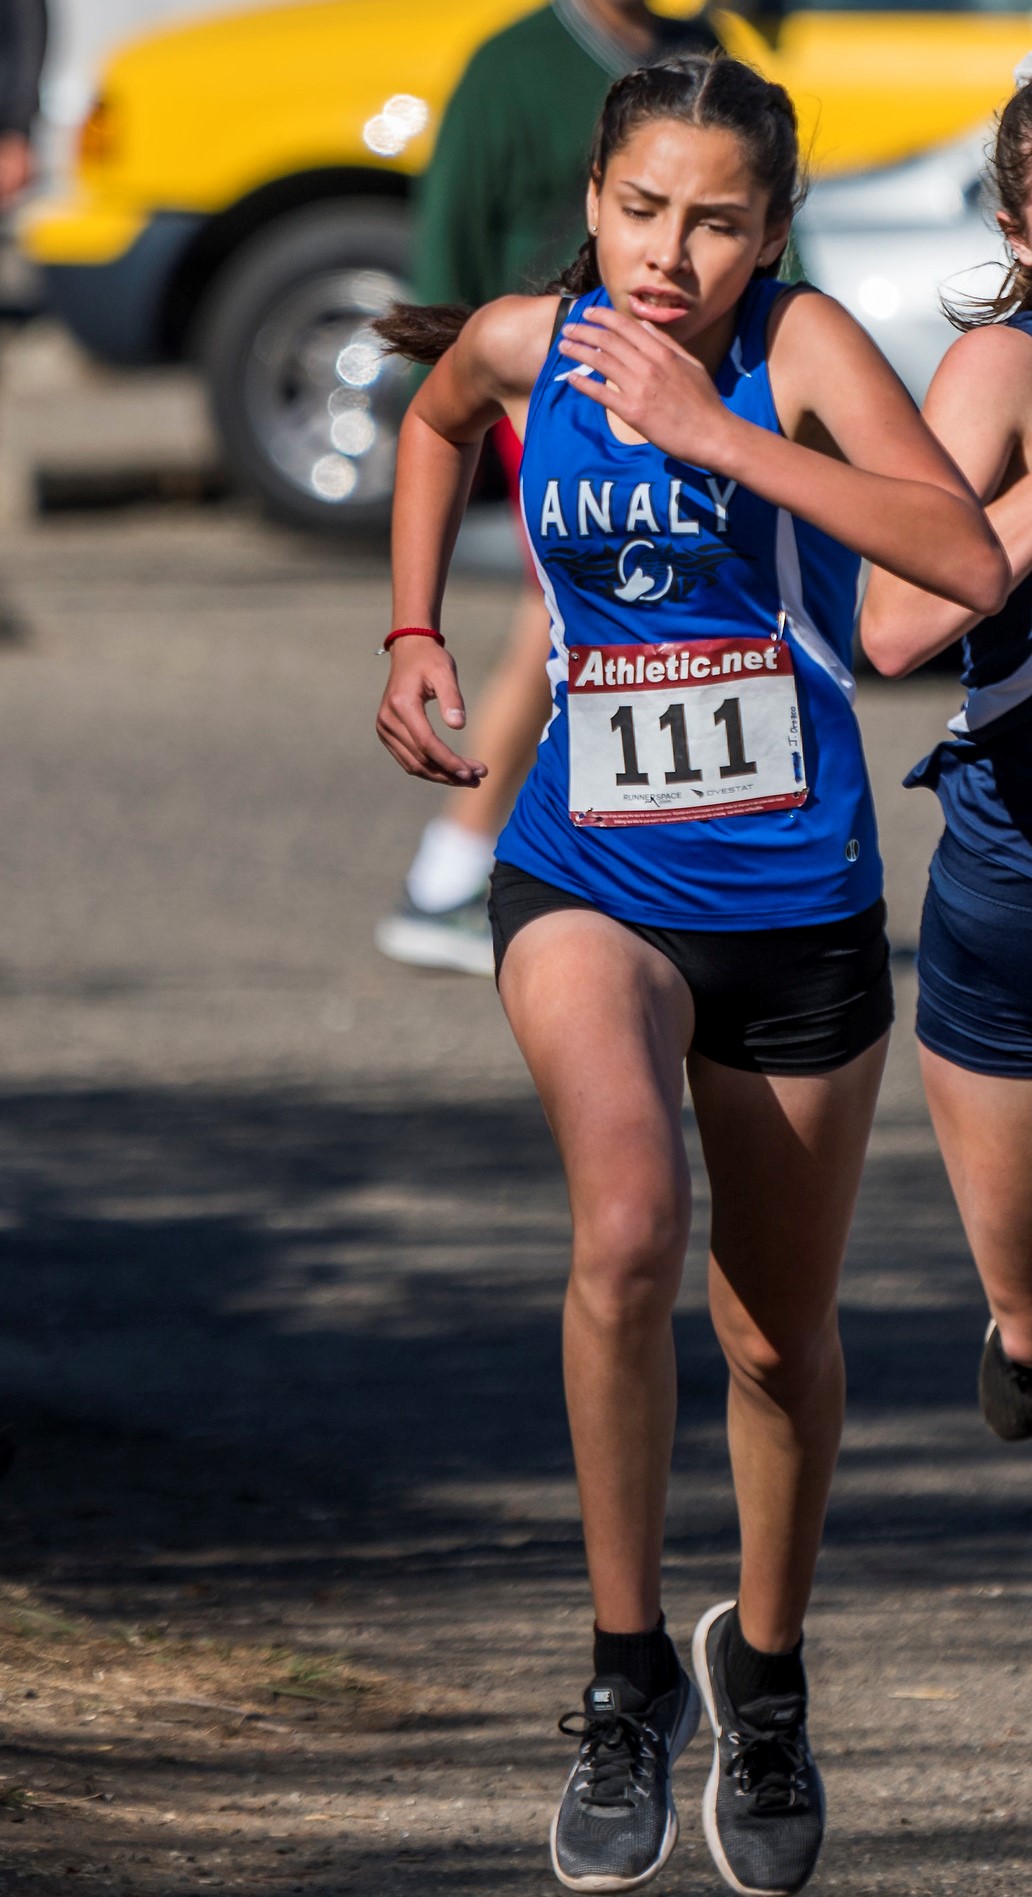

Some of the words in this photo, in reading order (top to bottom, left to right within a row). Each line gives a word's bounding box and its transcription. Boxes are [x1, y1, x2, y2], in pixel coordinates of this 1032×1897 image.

[540, 478, 738, 537] ANALY
[574, 648, 779, 687] Athletic.net
[610, 697, 758, 787] 111
